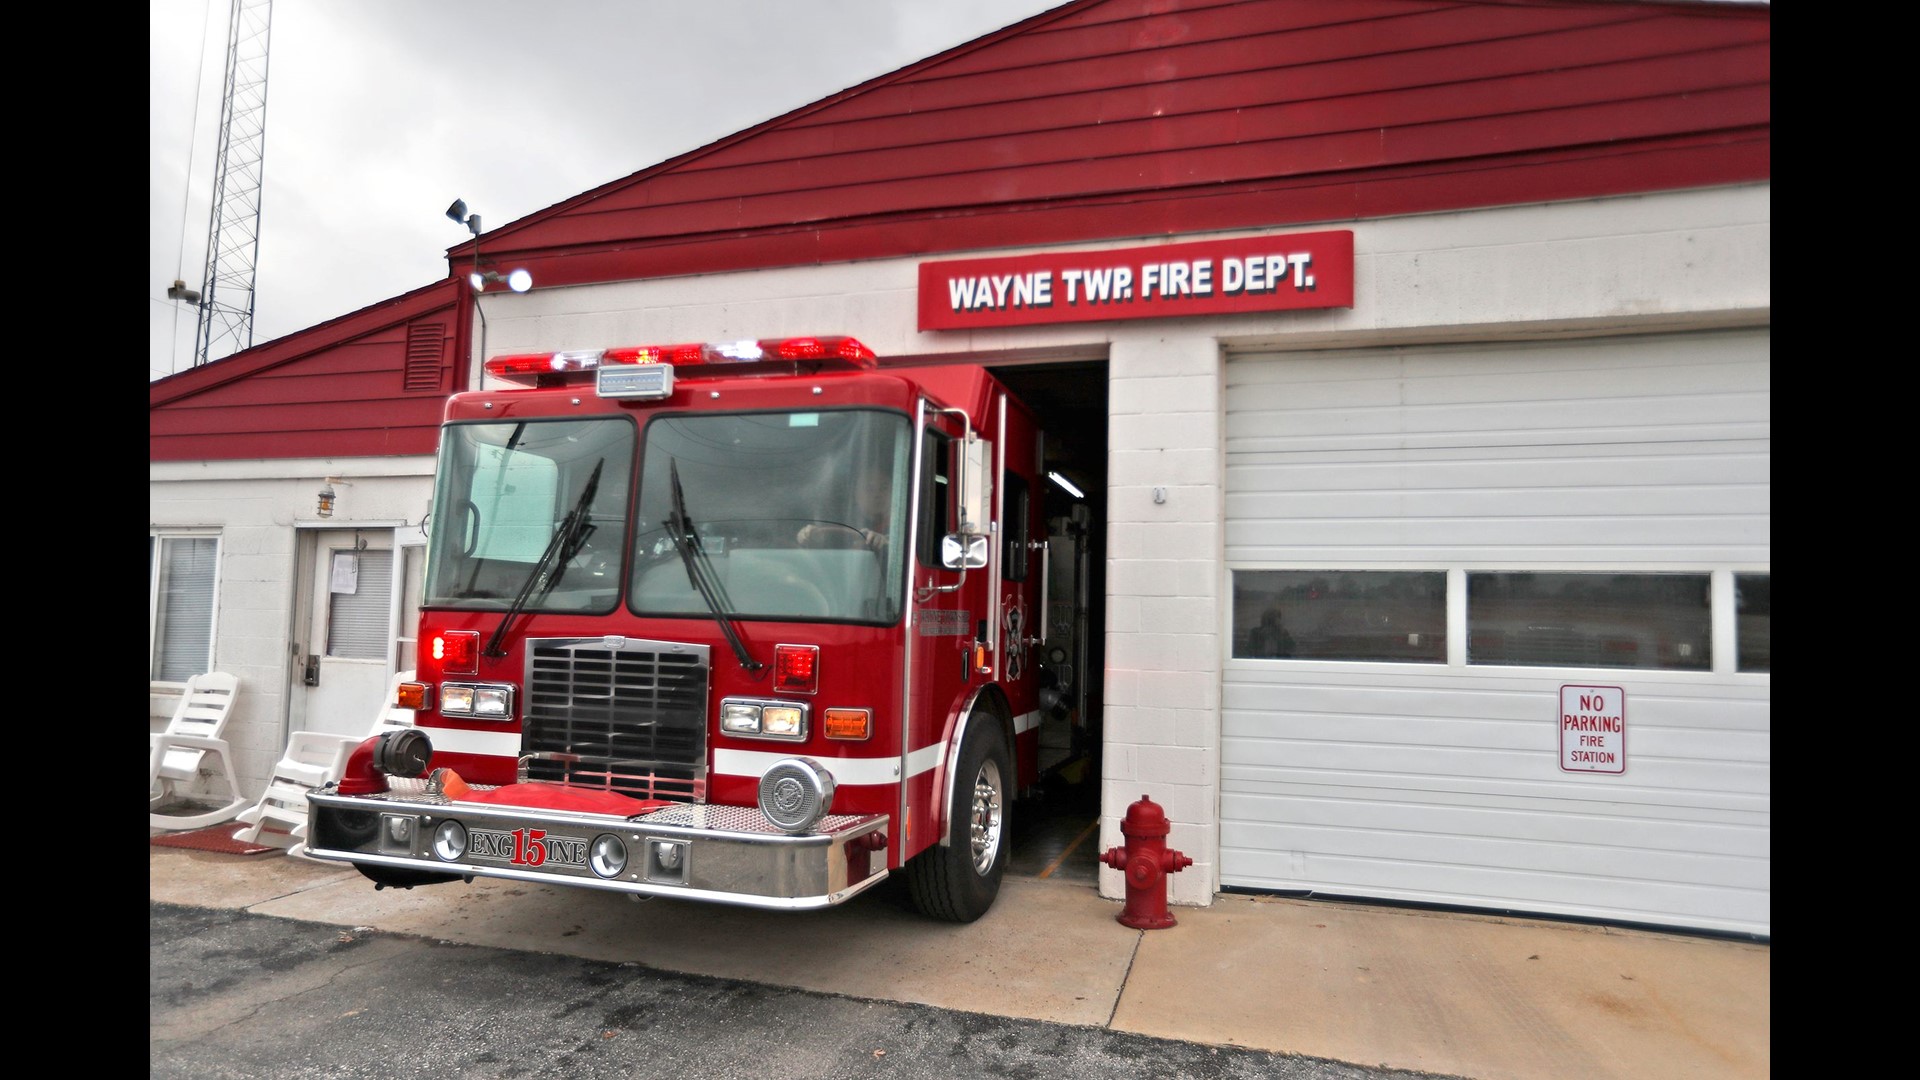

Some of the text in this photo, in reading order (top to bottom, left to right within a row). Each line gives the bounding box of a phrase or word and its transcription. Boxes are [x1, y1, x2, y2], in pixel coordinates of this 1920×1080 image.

[949, 271, 1053, 311] WAYNE
[1141, 259, 1213, 298] FIRE
[1222, 253, 1316, 292] DEPT.
[1580, 695, 1604, 712] NO
[1564, 714, 1621, 733] PARKING
[1580, 735, 1605, 748] FIRE
[1571, 750, 1615, 763] STATION
